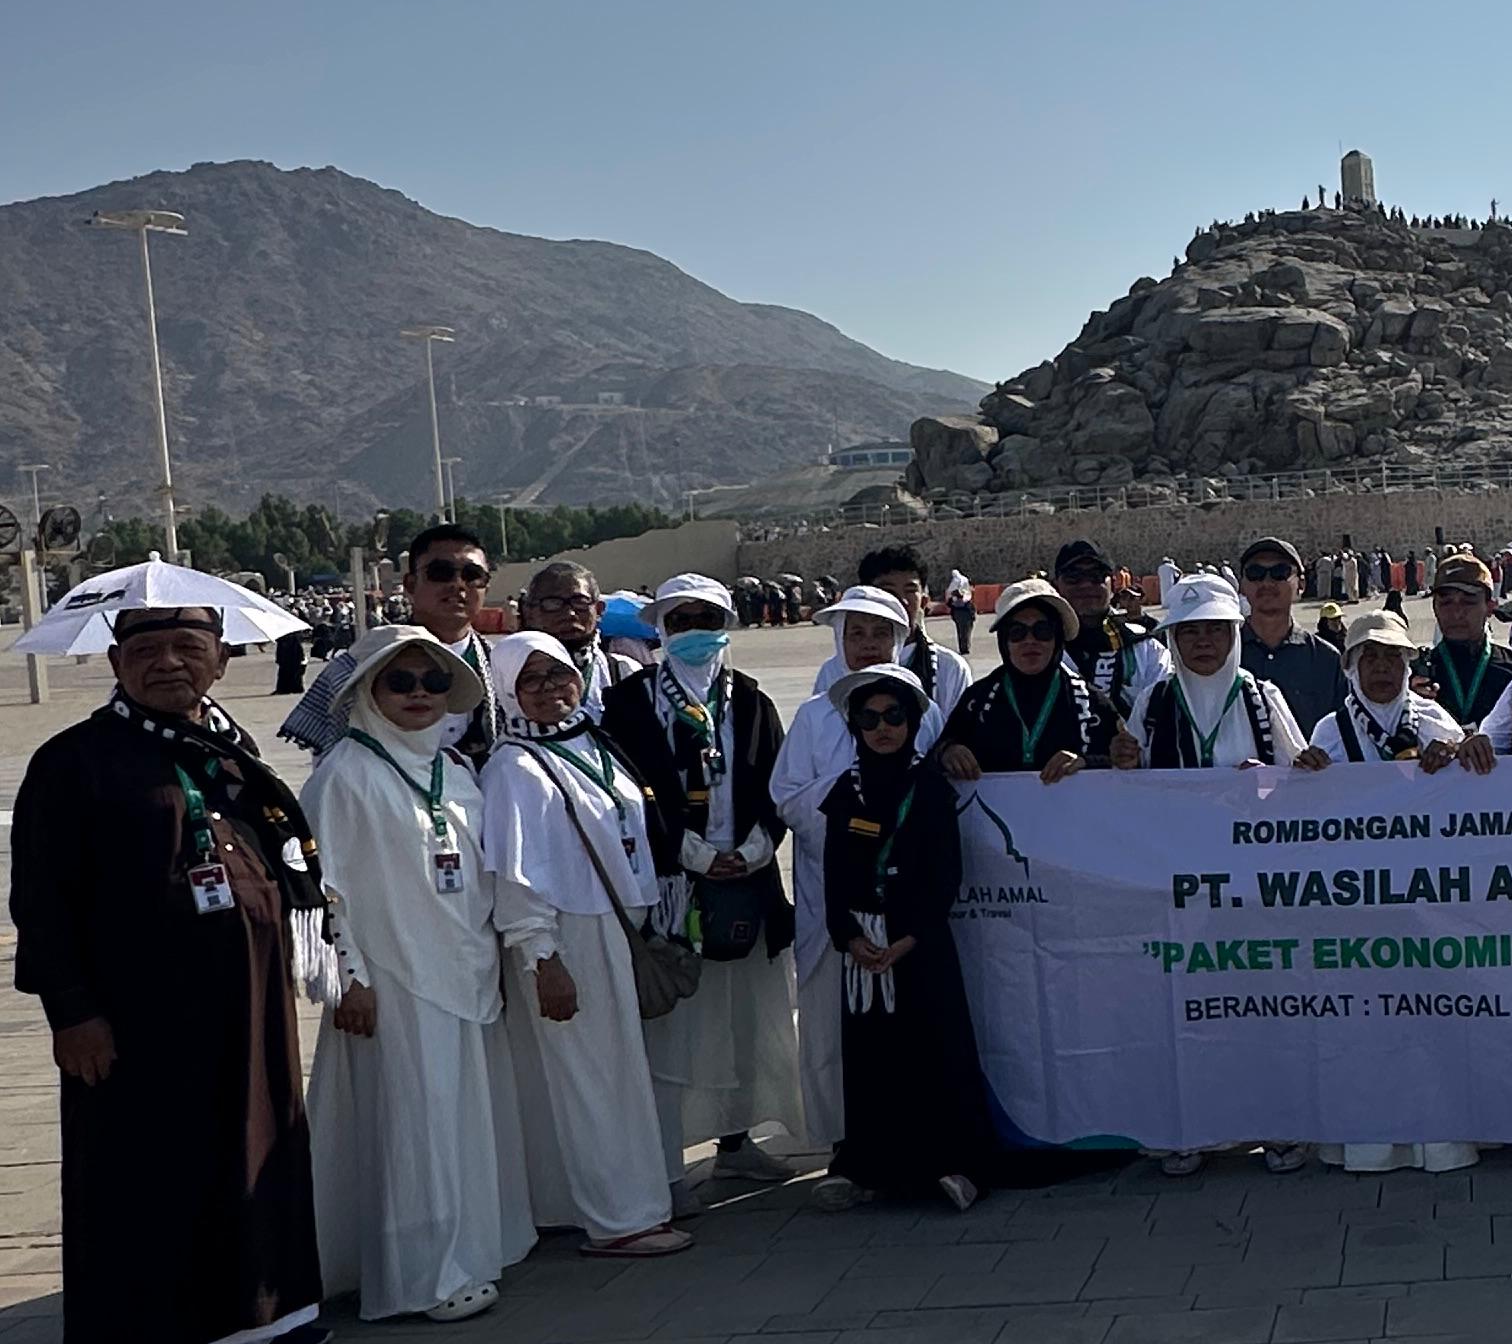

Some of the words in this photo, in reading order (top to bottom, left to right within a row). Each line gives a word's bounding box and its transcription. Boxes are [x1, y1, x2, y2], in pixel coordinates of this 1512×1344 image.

[1232, 814, 1431, 844] ROMBONGAN
[957, 886, 993, 904] LAH
[997, 886, 1049, 903] AMAL
[1172, 873, 1243, 909] PT.
[1256, 866, 1471, 908] WASILAH
[1185, 994, 1354, 1022] BERANGKAT
[1363, 999, 1370, 1016] :
[1378, 994, 1511, 1017] TANGGAL
